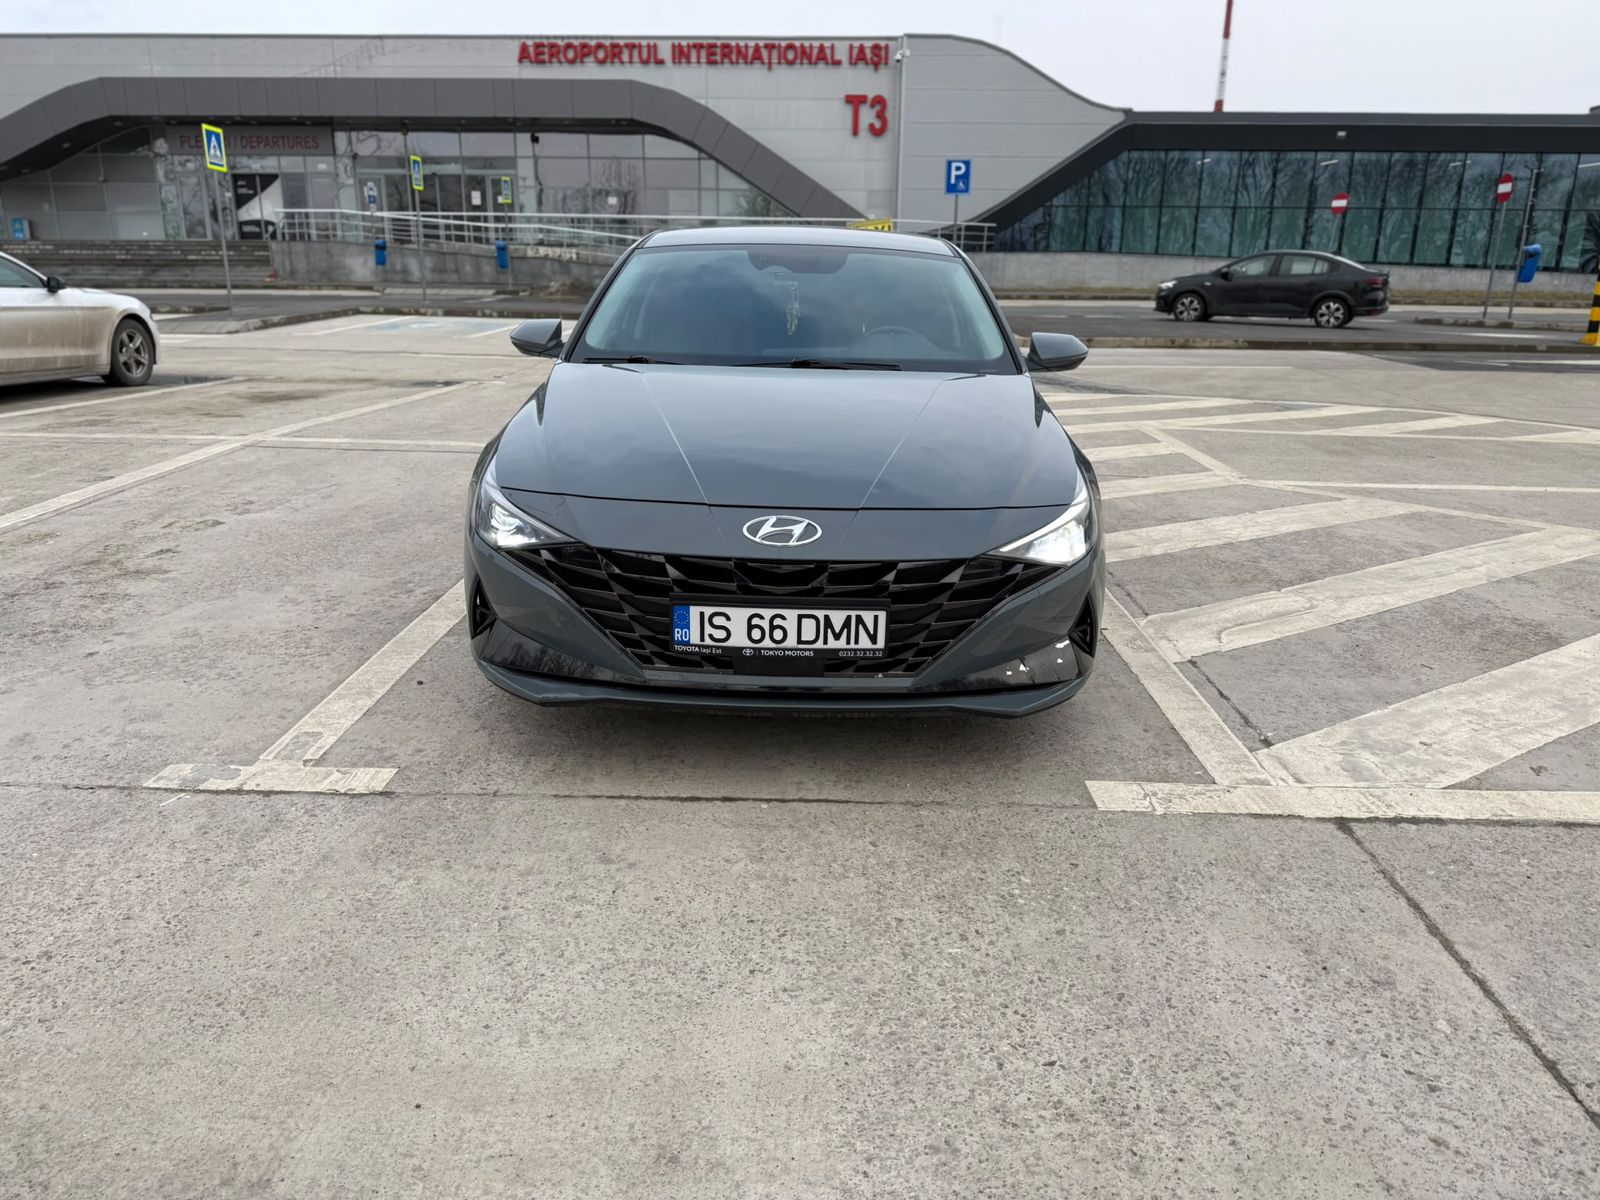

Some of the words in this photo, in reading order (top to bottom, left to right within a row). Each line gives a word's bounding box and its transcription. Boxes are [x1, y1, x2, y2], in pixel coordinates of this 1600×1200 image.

[518, 41, 665, 65] AEROPORTUL
[845, 94, 888, 137] T3
[240, 134, 320, 149] DEPARTURES
[950, 161, 966, 185] P
[674, 628, 689, 641] RO
[699, 611, 731, 643] IS
[746, 612, 788, 645] 66
[796, 613, 879, 646] DMN
[674, 644, 700, 653] TOYOTA
